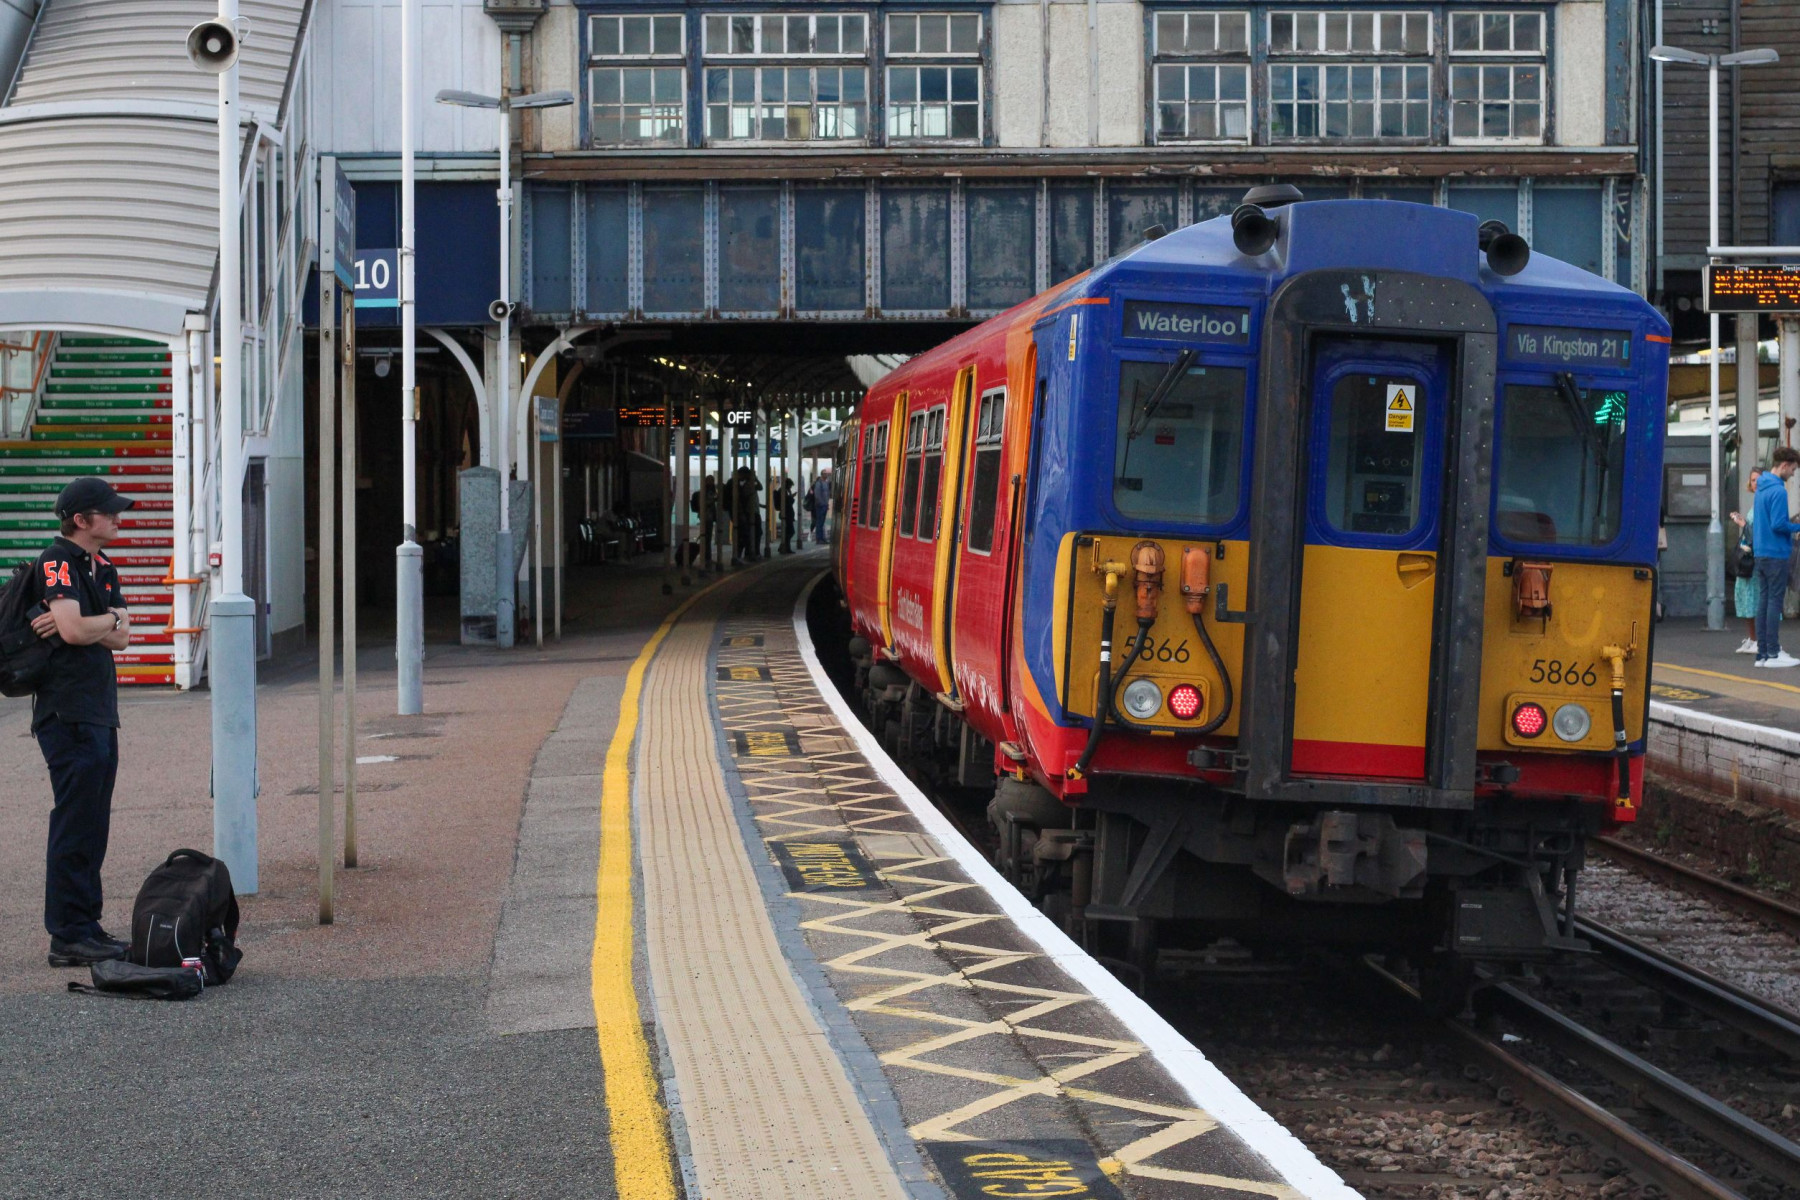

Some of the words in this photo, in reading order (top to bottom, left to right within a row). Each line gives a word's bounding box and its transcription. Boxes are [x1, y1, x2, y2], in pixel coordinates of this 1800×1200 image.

[354, 258, 390, 290] 10
[1137, 311, 1236, 336] Waterloo
[1518, 333, 1537, 353] Via
[1543, 335, 1598, 361] Kingston
[1601, 338, 1617, 358] 21
[727, 411, 752, 424] OFF
[738, 441, 751, 451] 10
[43, 560, 71, 587] 54
[1121, 636, 1190, 663] 5866
[1529, 659, 1597, 687] 5866
[801, 871, 867, 887] GAP
[962, 1152, 1089, 1198] GAP
